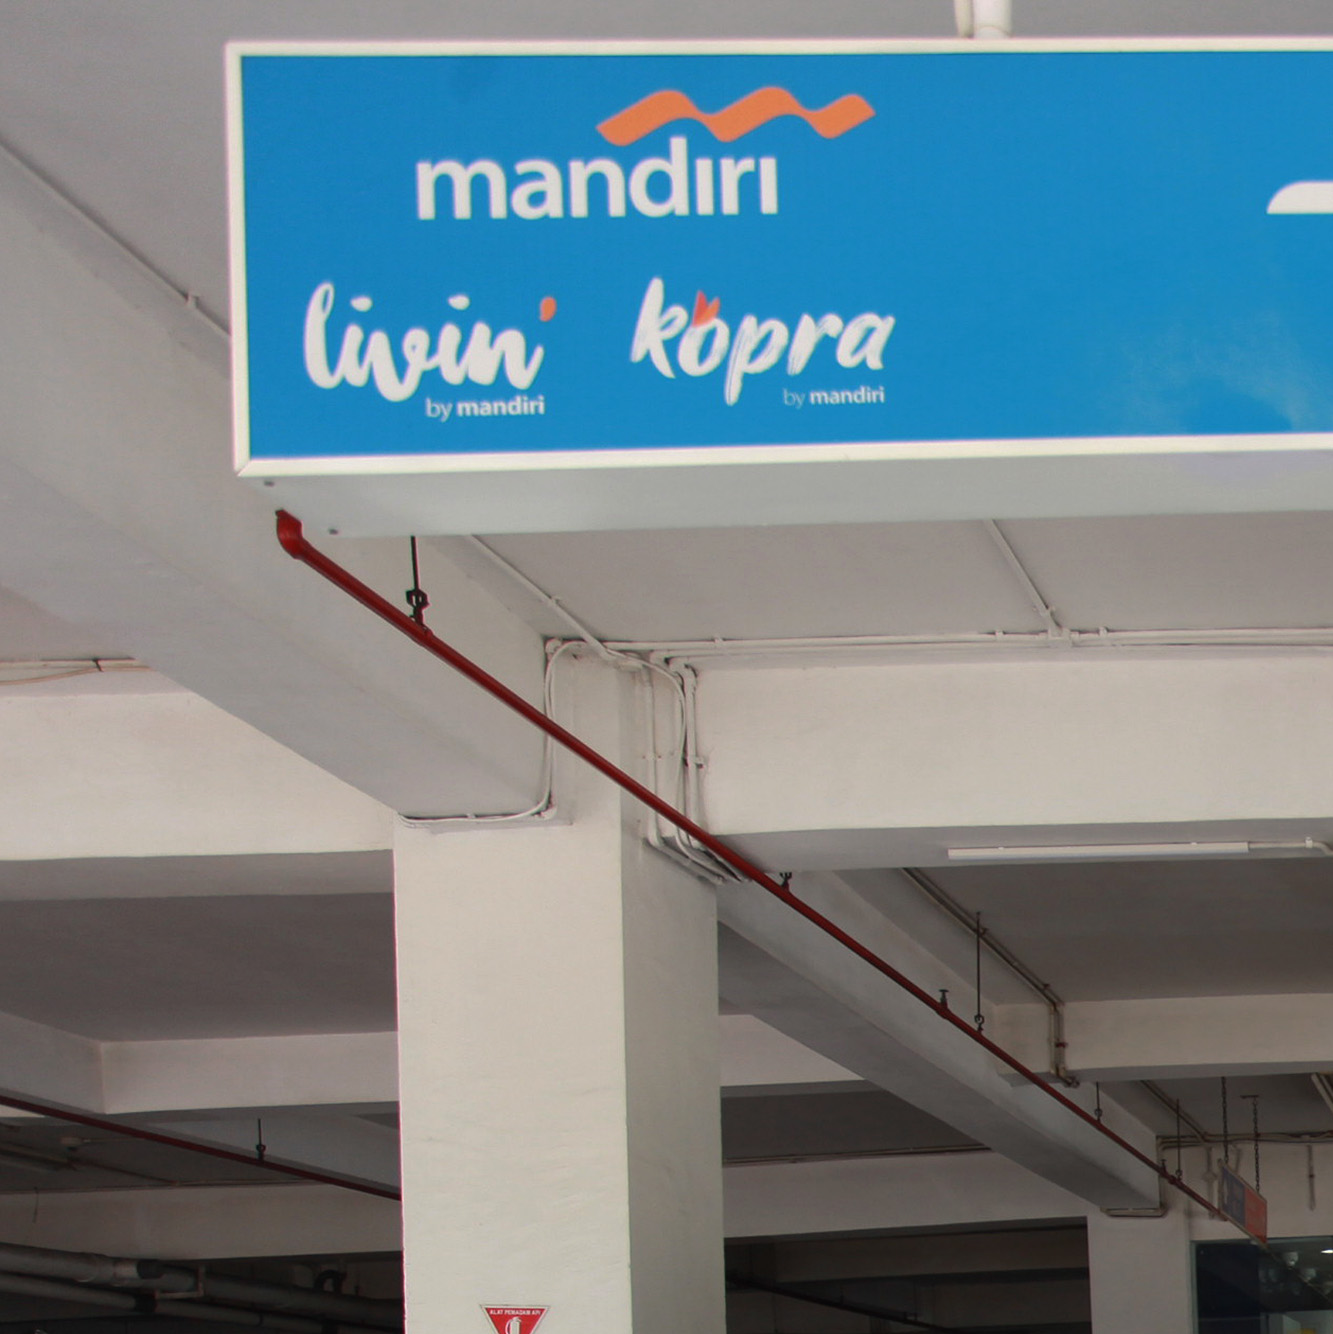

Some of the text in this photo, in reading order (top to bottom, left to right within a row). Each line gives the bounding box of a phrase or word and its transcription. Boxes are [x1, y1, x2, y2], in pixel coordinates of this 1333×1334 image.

[416, 136, 778, 220] mandiri
[630, 277, 895, 405] kopra
[425, 394, 545, 421] by mandiri
[783, 384, 885, 408] by mandiri
